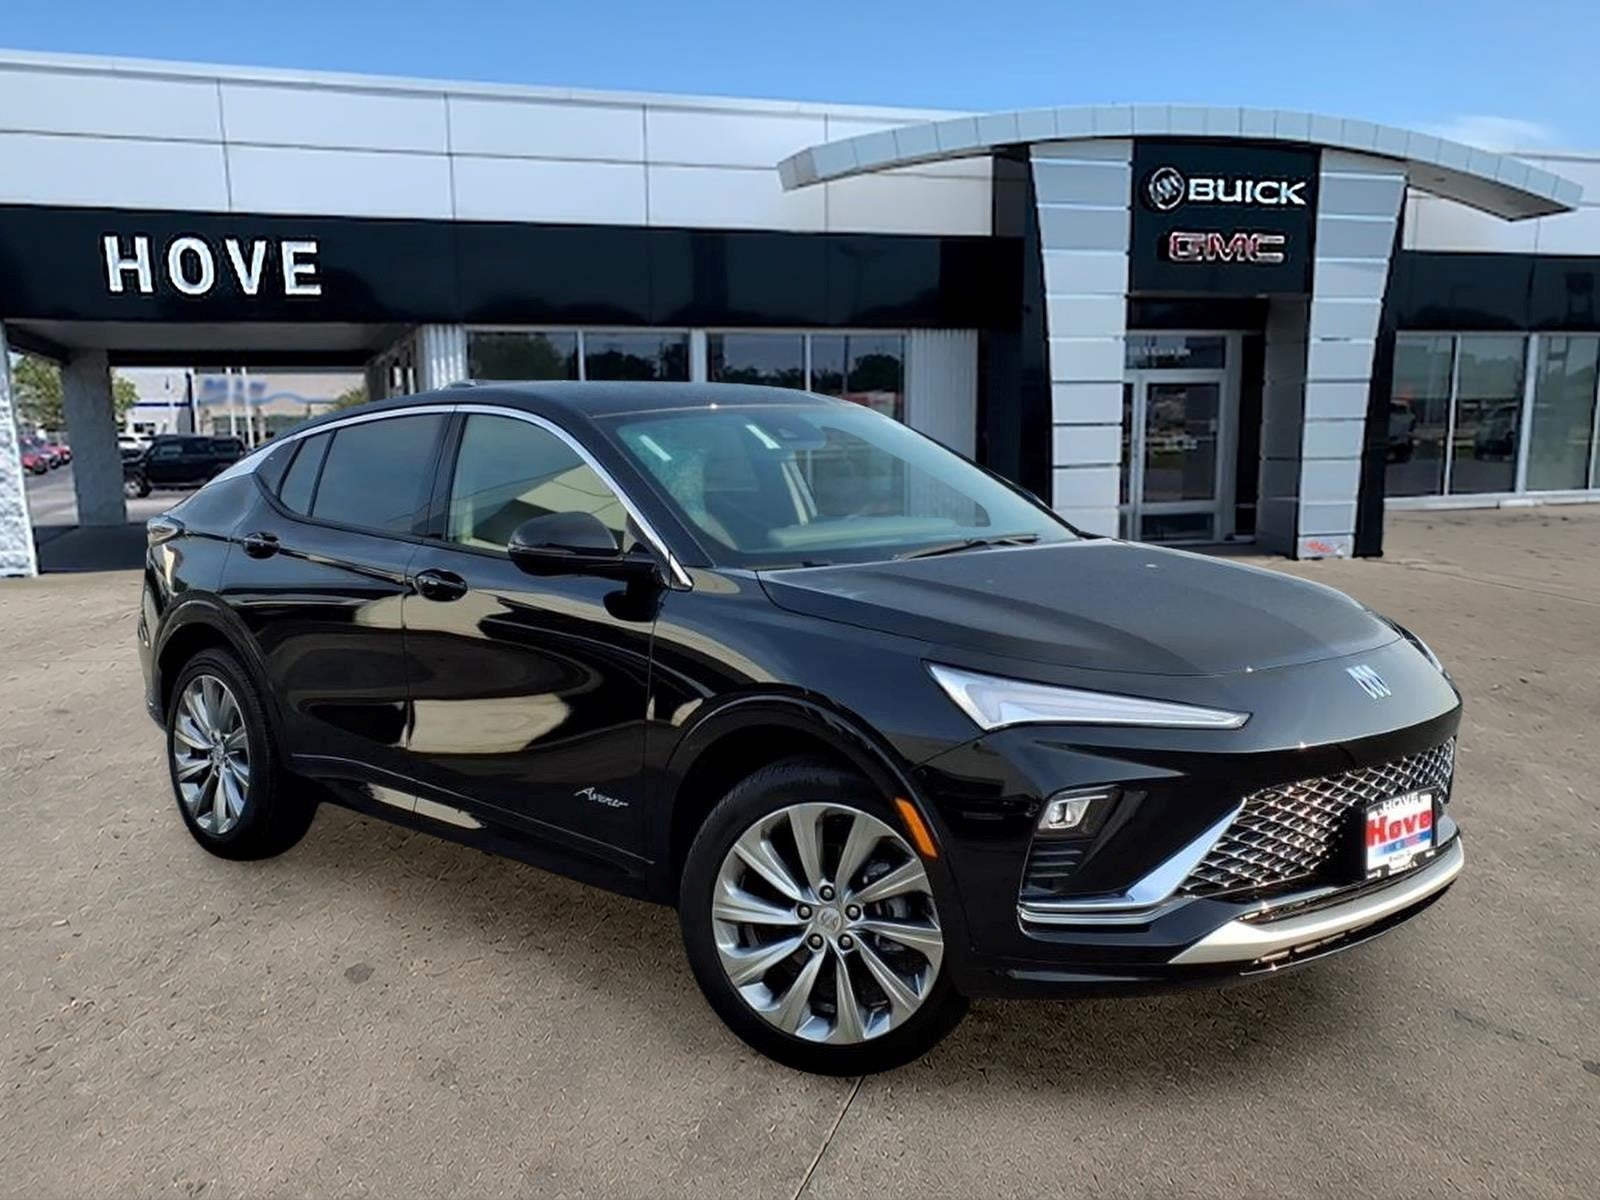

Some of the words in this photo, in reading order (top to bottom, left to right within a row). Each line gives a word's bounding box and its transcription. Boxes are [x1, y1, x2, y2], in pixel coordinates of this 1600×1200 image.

[1188, 178, 1306, 206] BUICK
[1168, 231, 1285, 263] GMC
[103, 235, 323, 296] HOVE
[1366, 810, 1433, 847] Hove
